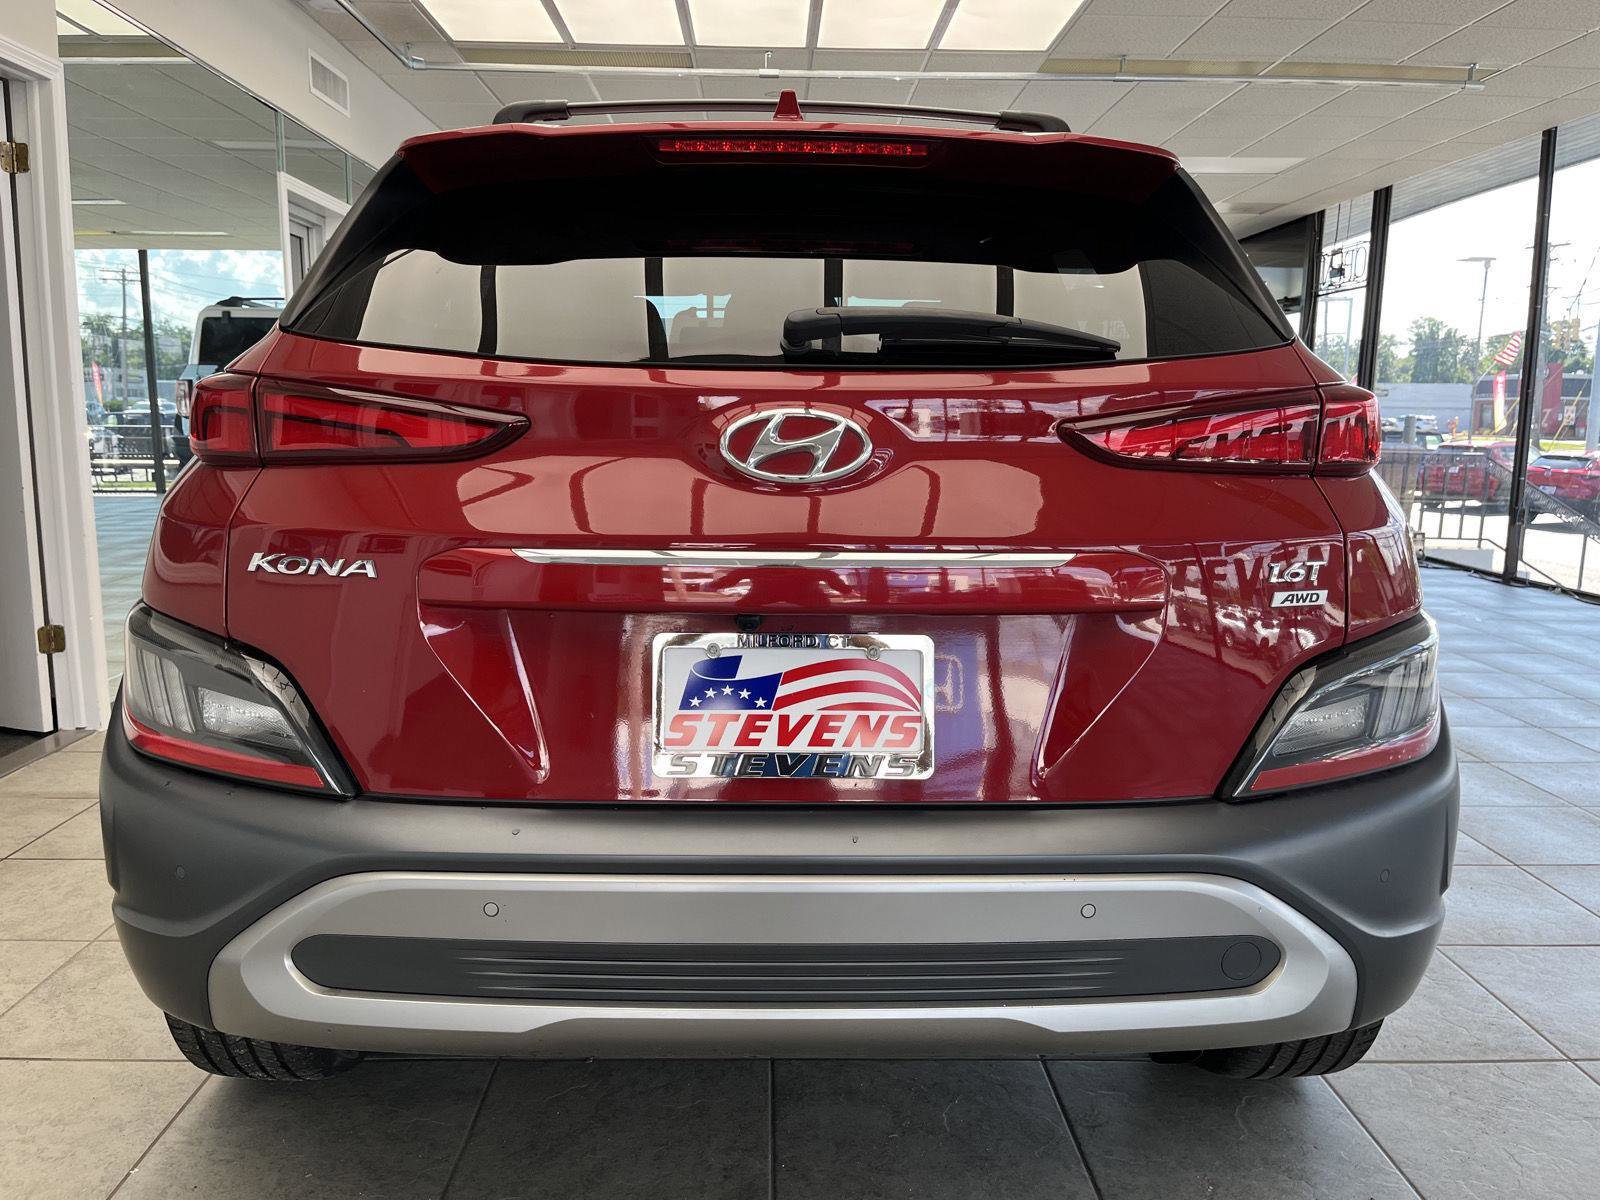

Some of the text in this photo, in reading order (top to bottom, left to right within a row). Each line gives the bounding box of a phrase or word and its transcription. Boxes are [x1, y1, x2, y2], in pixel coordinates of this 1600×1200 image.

[247, 552, 378, 579] KONA
[1280, 593, 1320, 605] AWD
[827, 634, 850, 648] CT
[664, 713, 922, 748] STEVENS
[667, 752, 919, 777] STEVENS
